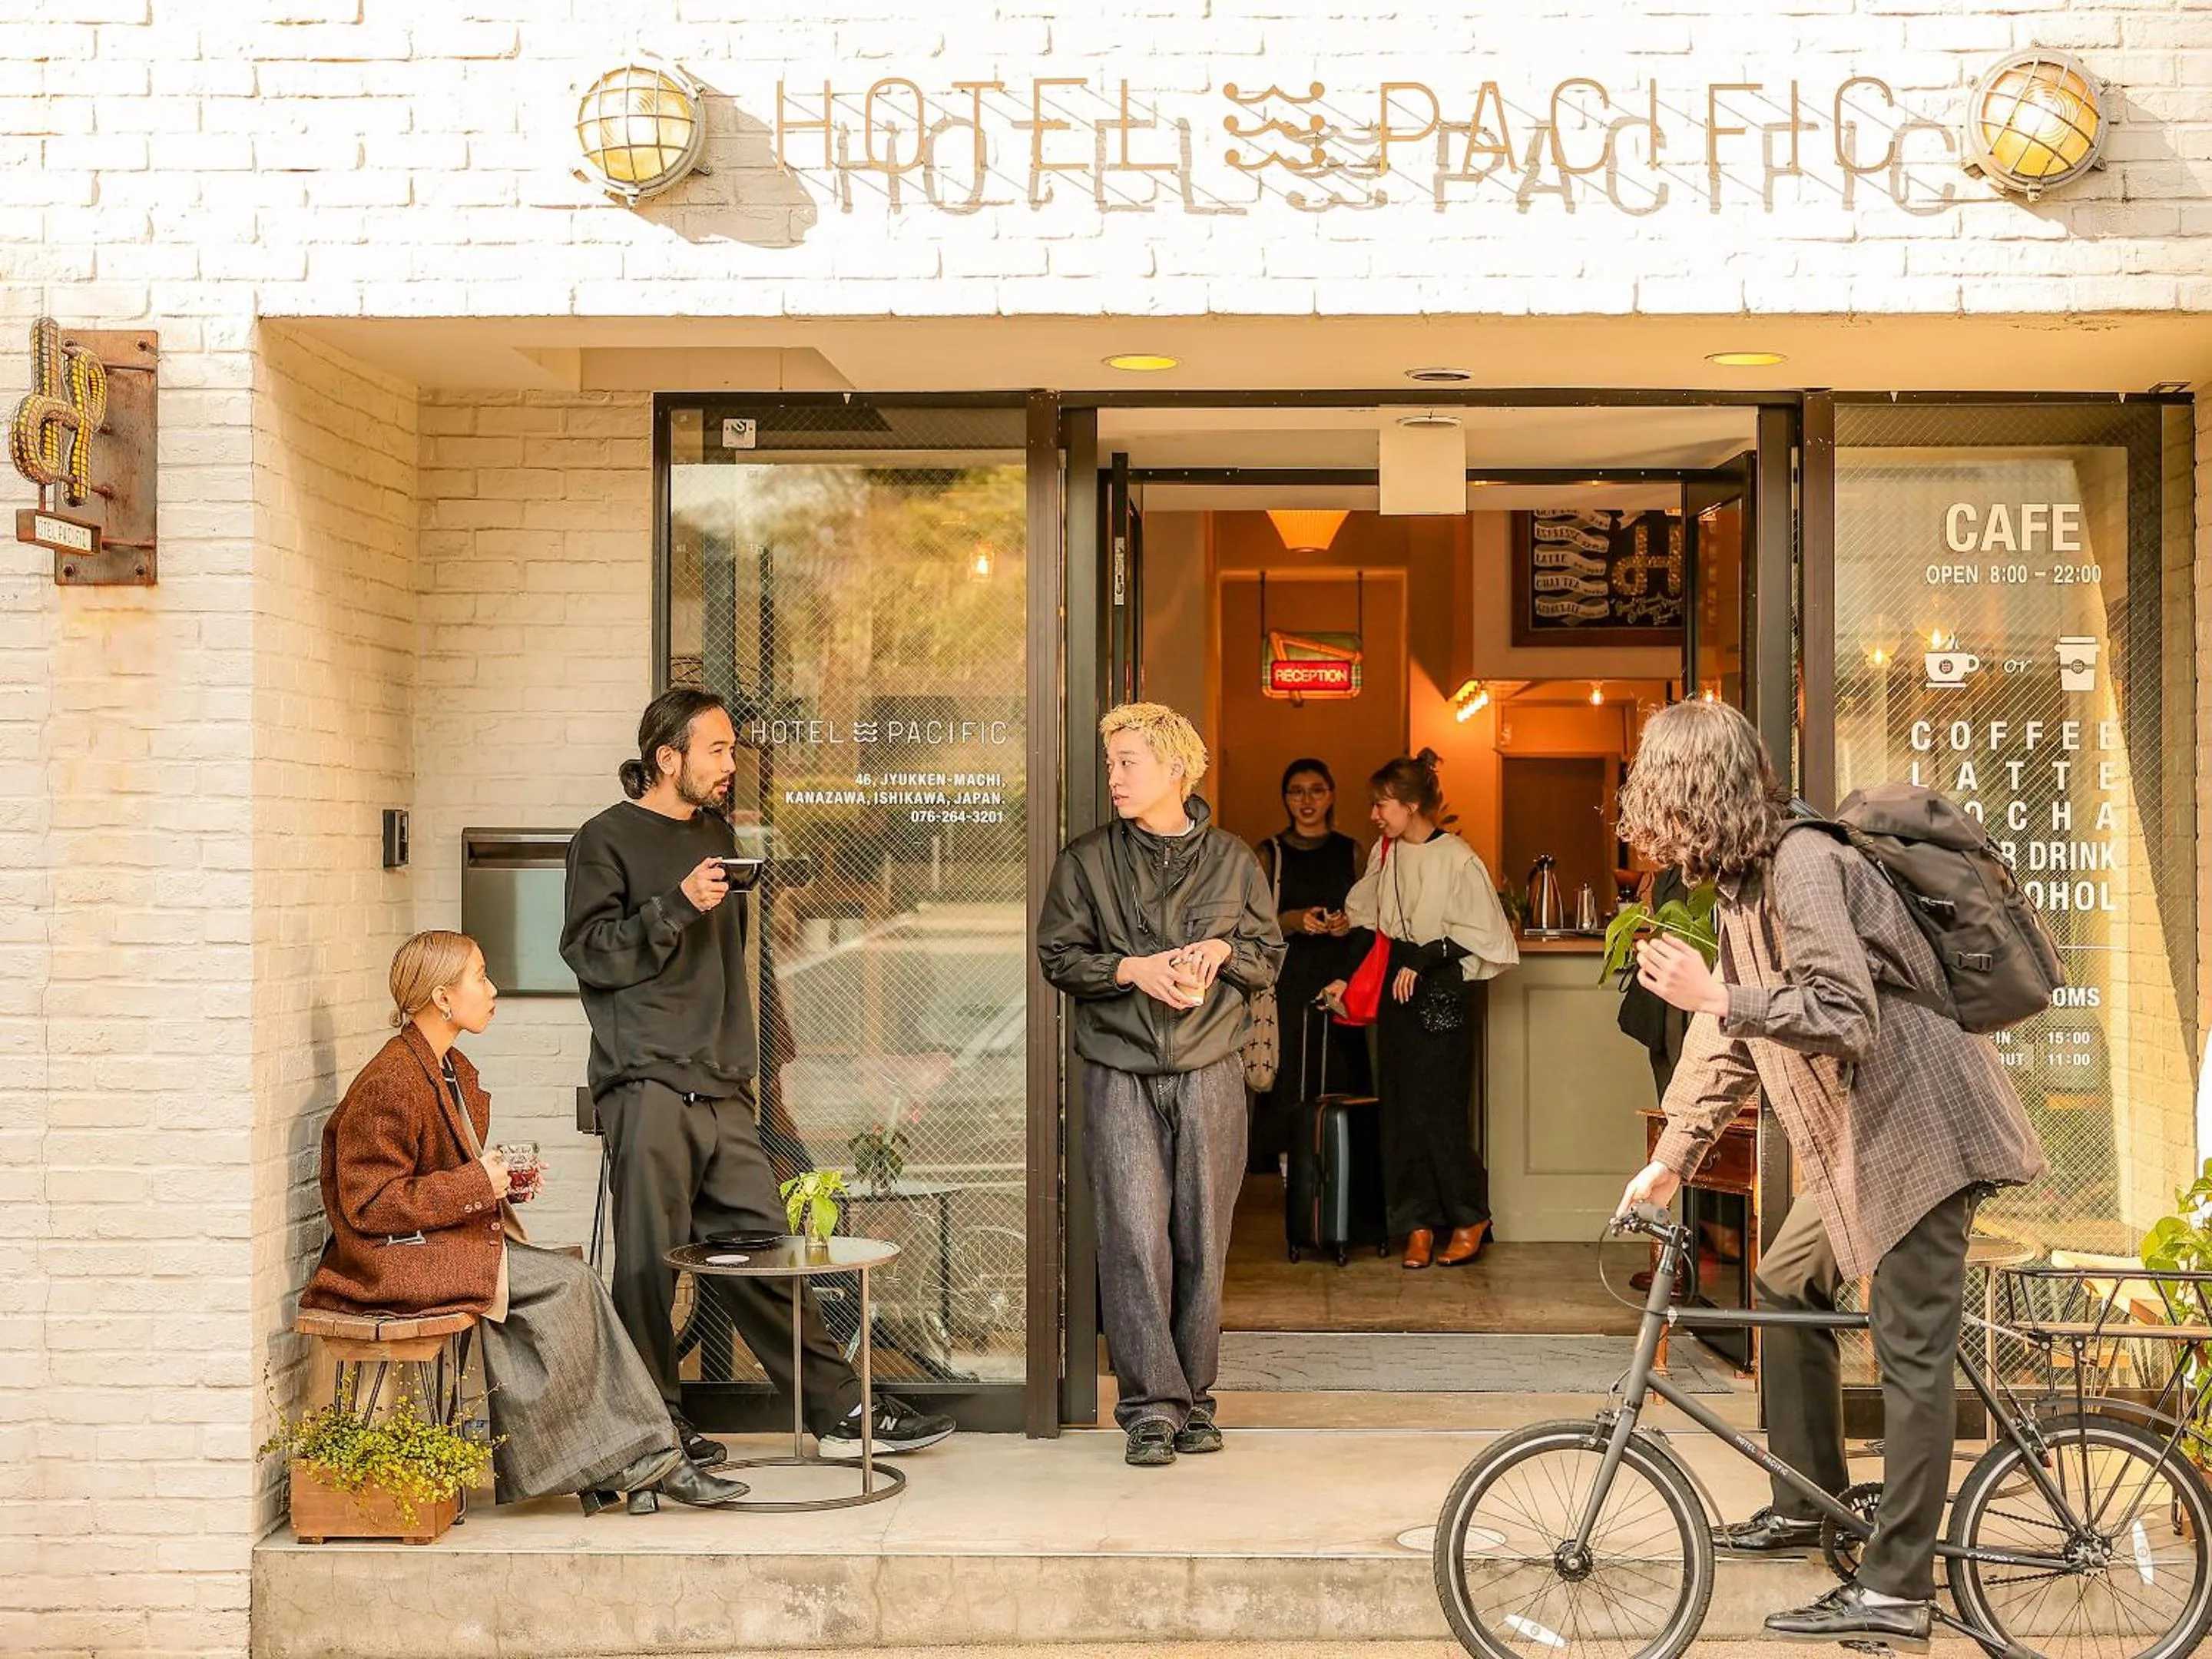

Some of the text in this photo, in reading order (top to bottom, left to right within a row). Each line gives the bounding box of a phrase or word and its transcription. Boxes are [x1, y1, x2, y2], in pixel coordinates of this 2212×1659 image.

[777, 77, 1895, 175] HOTEL PACIFIC
[1945, 503, 2081, 552] CAFE
[1926, 565, 1979, 584] OPEN
[1990, 565, 2027, 584] 8:00
[2053, 565, 2102, 584] 22:00
[1275, 669, 1348, 683] RECEPTION
[2003, 659, 2032, 674] or
[751, 720, 1008, 745] HOTEL PACIFIC
[1911, 720, 2119, 750] COFFEE
[855, 773, 1007, 788] 46, JYUKKEN-MACHI,
[1912, 760, 2120, 791] LATTE
[785, 792, 1005, 806] KANAZAWA, ISHIKAWA, JAPAN.
[911, 810, 1003, 823] 076-264-3201
[1963, 800, 2116, 831] OCHA
[2030, 841, 2118, 871] DRINK
[2025, 881, 2119, 911] OHOL
[2052, 987, 2101, 1007] OMS
[2048, 1031, 2091, 1045] 15:00
[2048, 1053, 2091, 1066] 11:00
